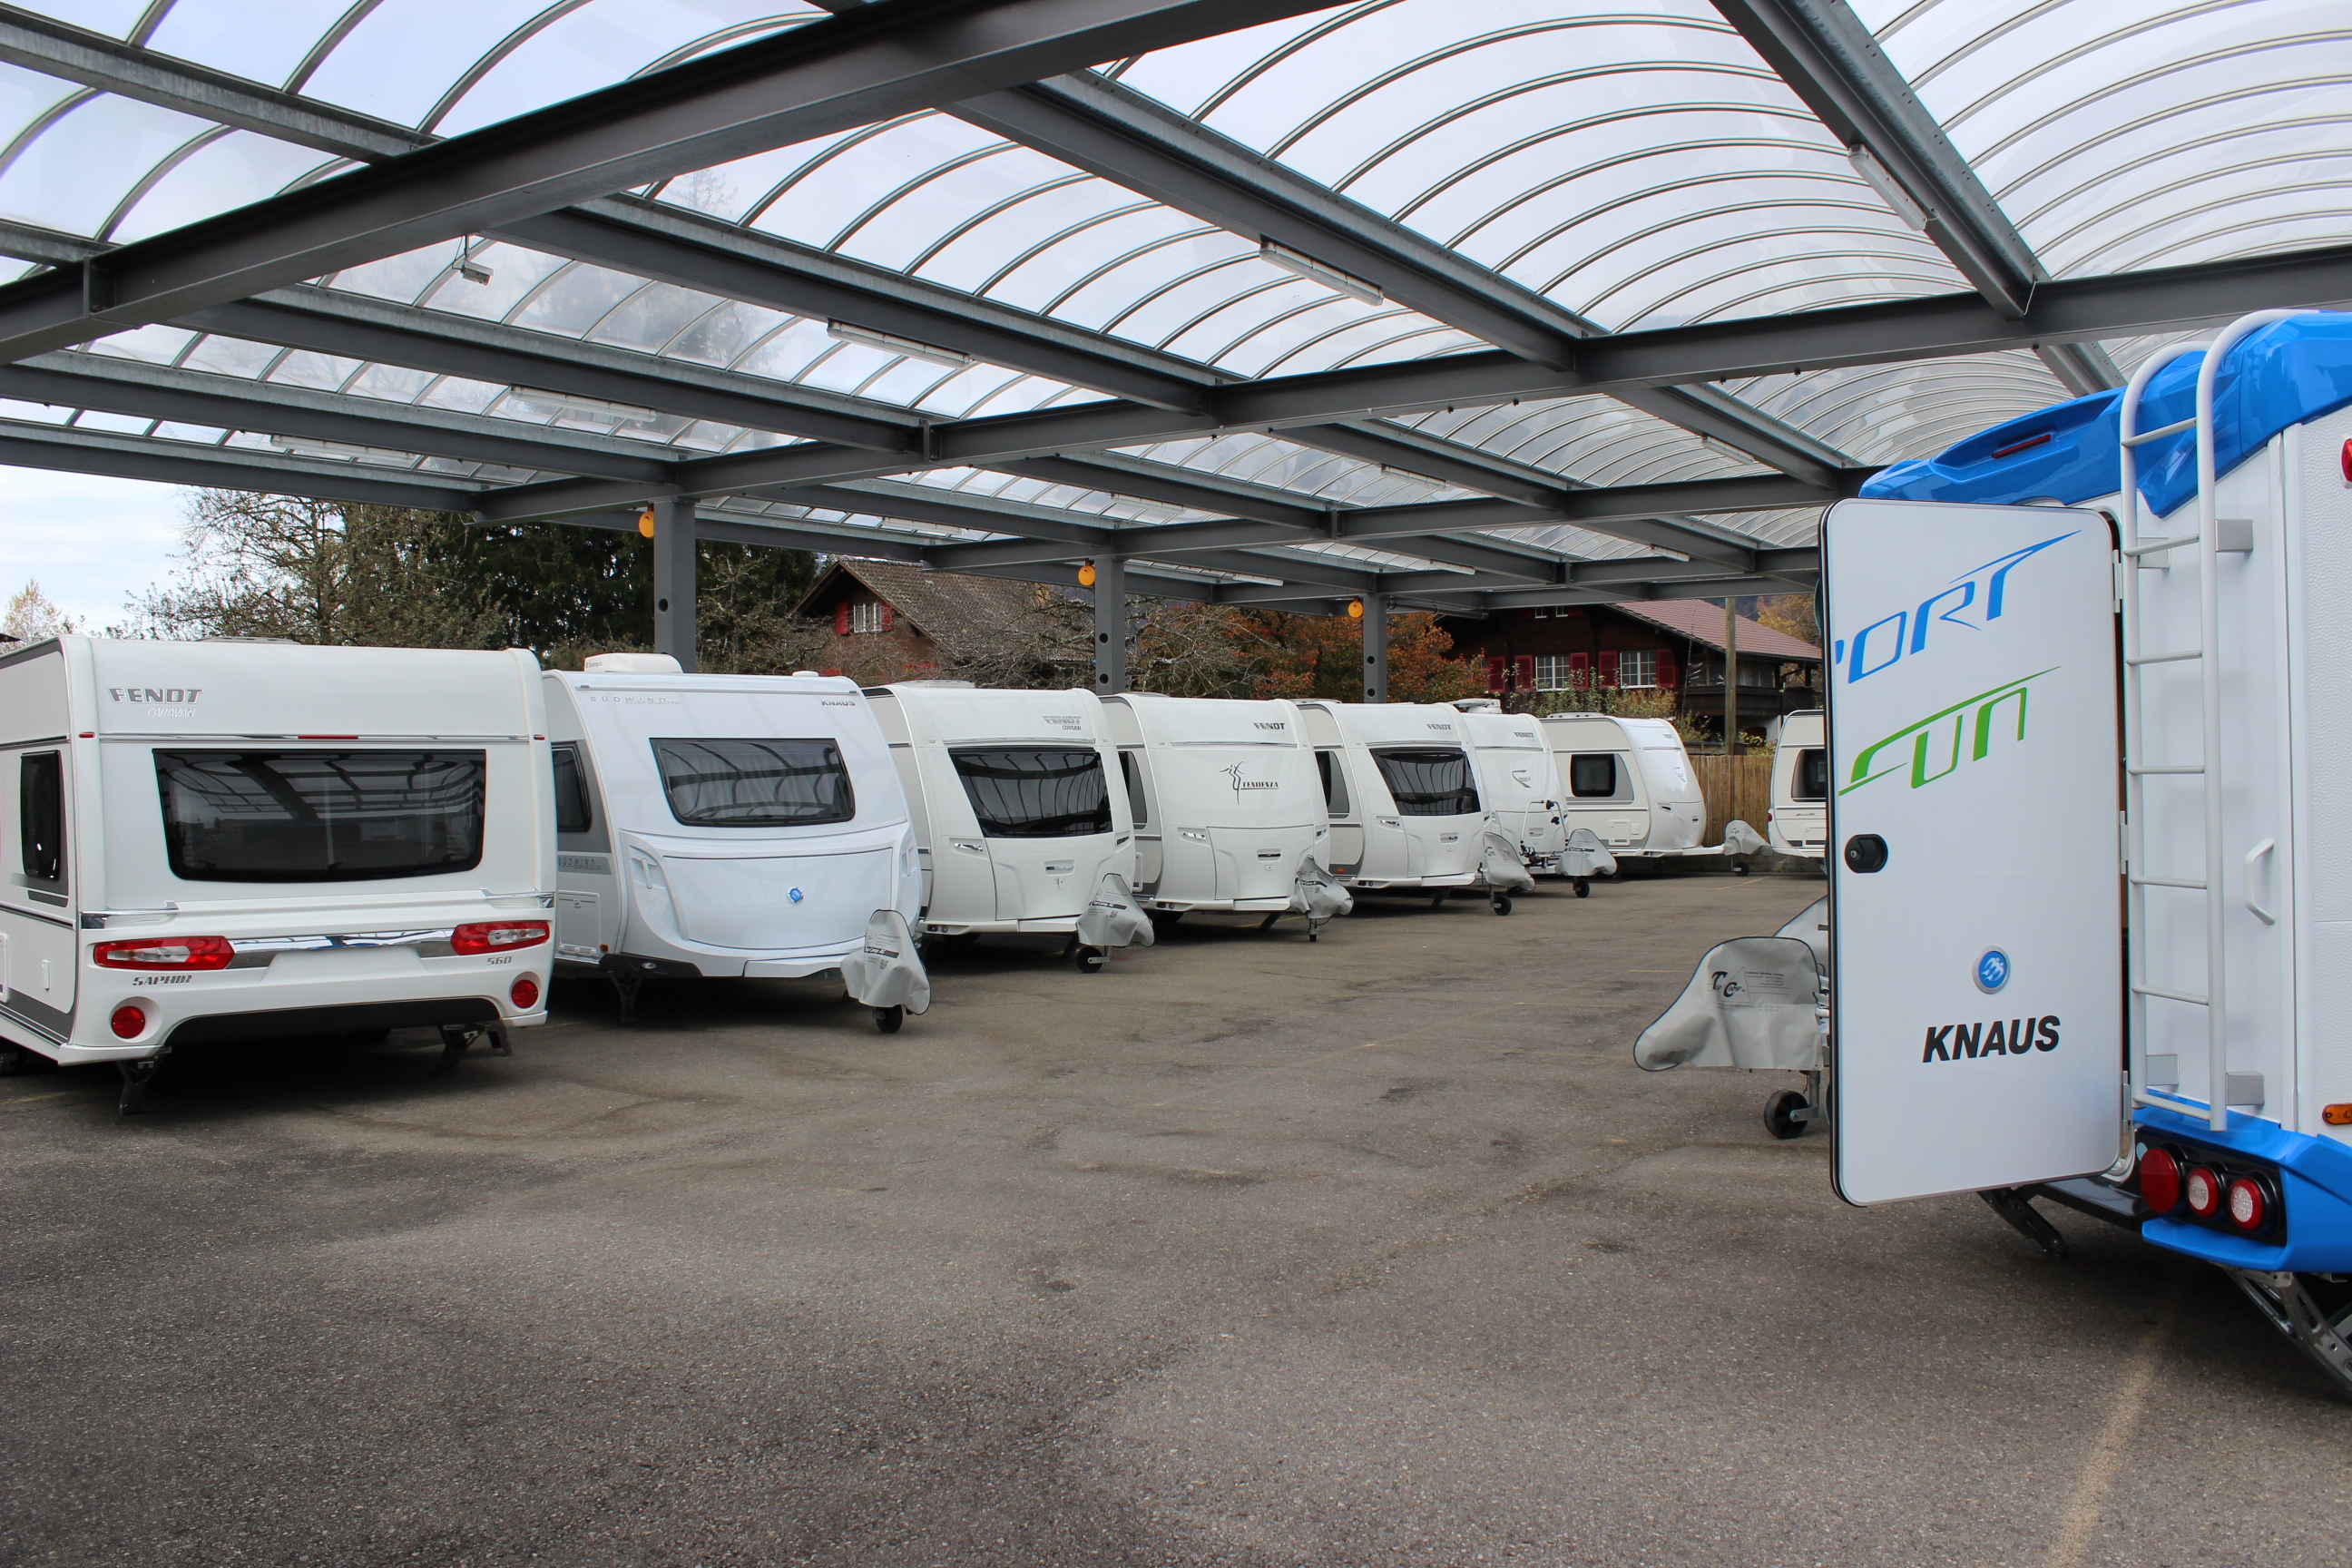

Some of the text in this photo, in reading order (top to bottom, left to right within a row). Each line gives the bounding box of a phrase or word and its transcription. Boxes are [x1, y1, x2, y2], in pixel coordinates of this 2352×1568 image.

[107, 688, 203, 704] FENDT
[147, 708, 196, 718] CARAVAN
[1042, 715, 1082, 724] FENDT
[486, 956, 513, 965] 560
[132, 975, 192, 986] SAPHIR
[1922, 1014, 2061, 1063] KNAUS
